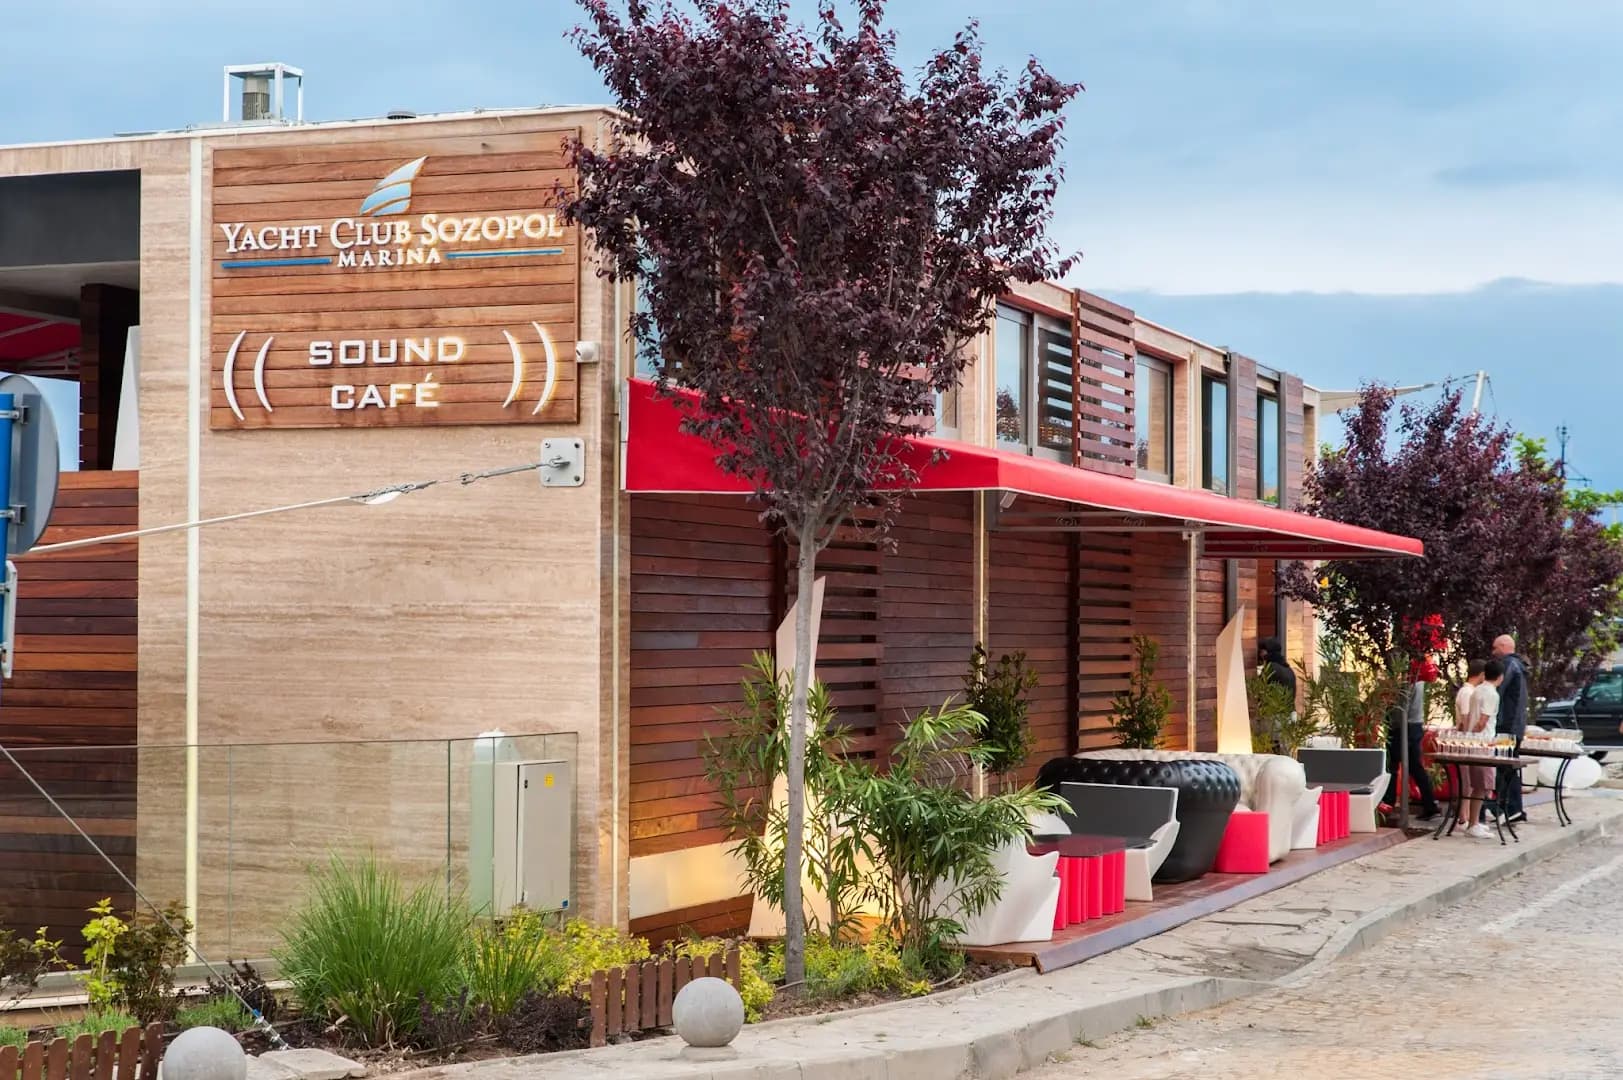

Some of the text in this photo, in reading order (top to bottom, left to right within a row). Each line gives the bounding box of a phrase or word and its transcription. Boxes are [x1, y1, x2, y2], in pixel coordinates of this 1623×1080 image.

[220, 213, 563, 253] YACHT CLUB SOZOPOL
[337, 248, 441, 267] MARINA
[309, 336, 466, 366] SOUND
[331, 373, 441, 410] CAFÉ
